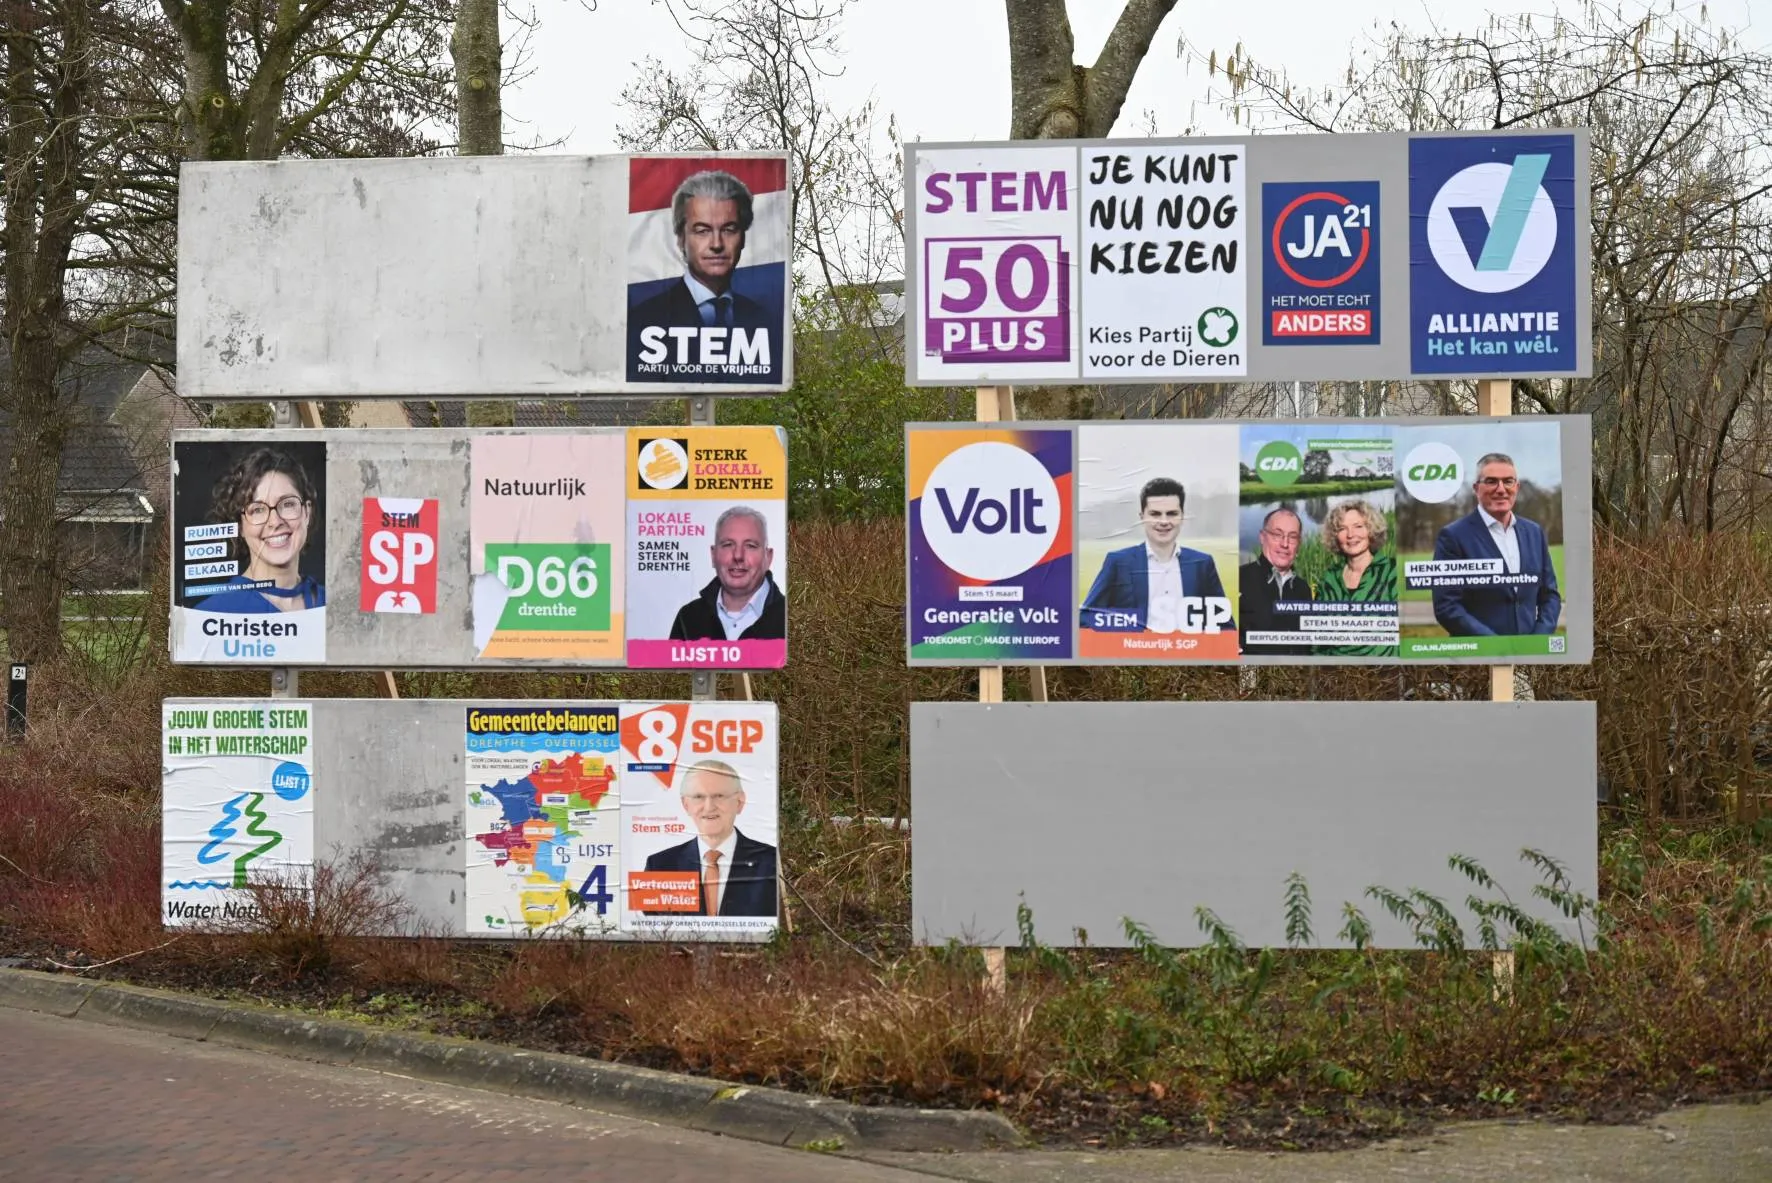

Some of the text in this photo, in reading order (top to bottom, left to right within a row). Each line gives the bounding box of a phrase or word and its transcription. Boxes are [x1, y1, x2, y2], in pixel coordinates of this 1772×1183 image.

[1089, 153, 1238, 185] JE KUNT
[925, 171, 1068, 214] STEM
[1090, 194, 1238, 231] NU NOG
[1090, 240, 1238, 275] KIEZEN
[940, 243, 1049, 313] 50
[1271, 294, 1371, 307] HET MOET ECHT
[1277, 314, 1366, 332] ANDERS
[1428, 312, 1559, 333] ALLIANTIE
[943, 320, 1045, 352] PLUS
[1089, 325, 1192, 346] Kies Partij
[638, 325, 771, 365] STEM
[1428, 335, 1559, 356] Het kan wél.
[1089, 350, 1240, 367] voor de Dieren
[638, 364, 771, 376] PARTIJ VOOR DE VRIJHEID
[695, 449, 747, 461] STERK
[1259, 456, 1298, 471] CDA
[695, 463, 761, 475] LOKAAL
[1408, 463, 1457, 481] CDA
[484, 478, 586, 500] Natuurlijk
[695, 478, 773, 490] DRENTHE
[638, 512, 691, 524] LOKALE
[934, 487, 1047, 535] Volt
[381, 512, 419, 529] STEM
[187, 525, 235, 539] RUIMTE
[638, 525, 705, 537] PARTIJEN
[187, 546, 223, 557] VOOR
[638, 541, 679, 550] SAMEN
[368, 530, 435, 585] SP
[638, 551, 689, 561] STERK IN
[187, 563, 235, 577] ELKAAR
[638, 562, 690, 572] DRENTHE
[1410, 562, 1496, 573] HENK JUMELET
[498, 556, 598, 598] D66
[1433, 576, 1465, 586] staan
[1466, 576, 1490, 585] voor
[1492, 574, 1539, 584] Drenthe
[518, 602, 577, 617] drenthe
[924, 607, 1059, 624] Generatie Volt
[1276, 603, 1397, 612] WATER BEHEER JE SAMEN
[202, 618, 298, 637] Christen
[1094, 613, 1137, 627] STEM
[223, 638, 276, 657] Unie
[922, 636, 1060, 645] TOEKOMST MADE IN EUROPE
[1123, 638, 1198, 651] Natuurlijk SGP
[671, 646, 741, 662] LIJST 10
[168, 709, 308, 730] JOUW GROENE STEM
[469, 710, 617, 733] Gemeentebelangen
[169, 736, 308, 755] IN HET WATERSCHAP
[638, 710, 764, 764] 8 SGP
[632, 823, 686, 833] Stem SGP
[579, 844, 613, 858] LIJST
[577, 865, 614, 915] 4
[632, 880, 696, 890] Vertrouwd
[660, 894, 697, 905] Water
[168, 901, 219, 919] Water
